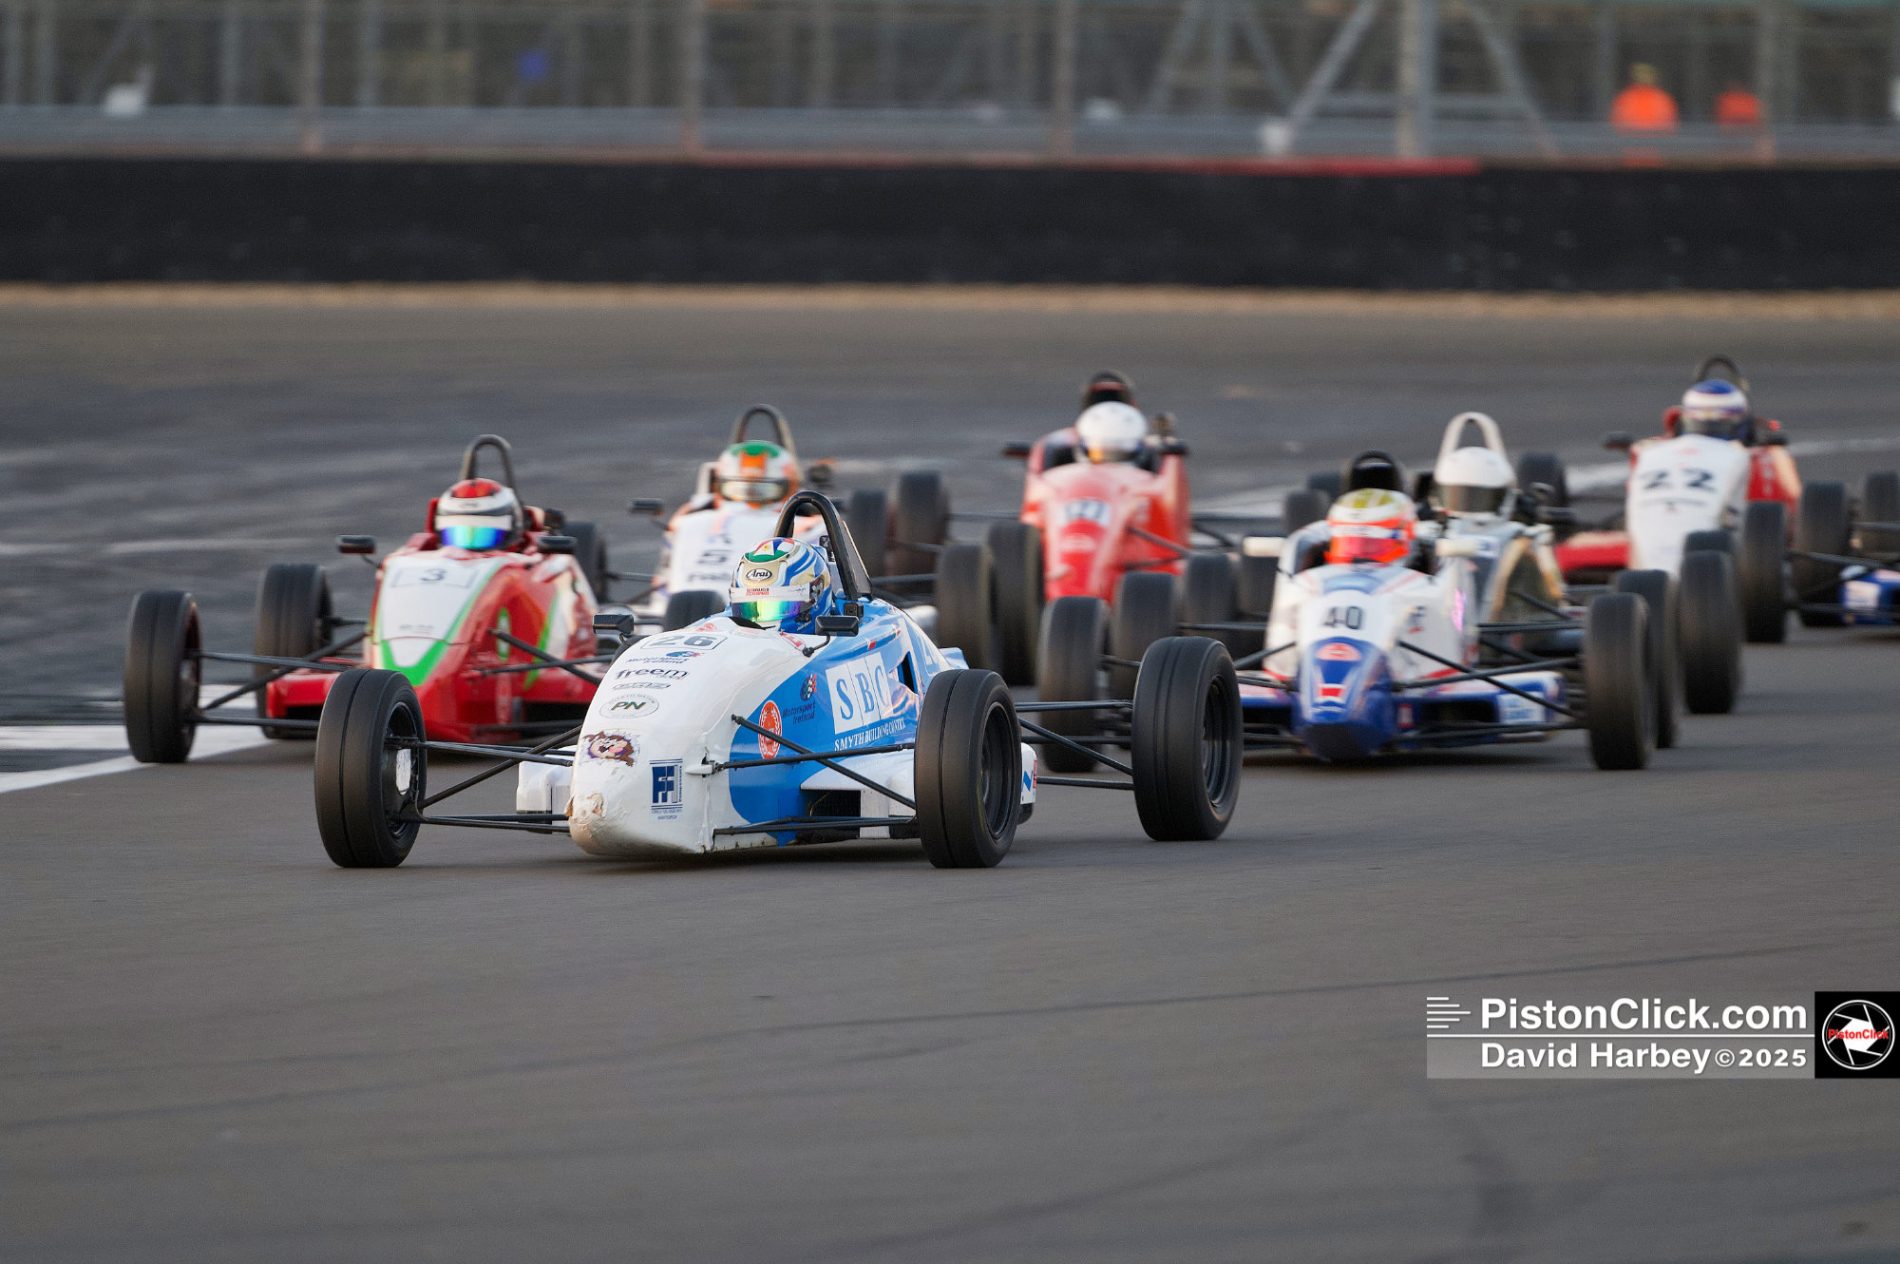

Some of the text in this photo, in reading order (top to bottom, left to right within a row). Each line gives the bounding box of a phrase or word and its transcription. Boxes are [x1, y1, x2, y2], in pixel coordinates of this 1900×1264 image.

[1639, 467, 1718, 493] 22
[419, 568, 449, 582] 3
[1322, 604, 1365, 631] 40
[648, 635, 718, 648] 26
[615, 667, 689, 680] freem
[835, 664, 890, 721] SBC
[610, 700, 647, 711] PN
[834, 731, 865, 752] SMYTH
